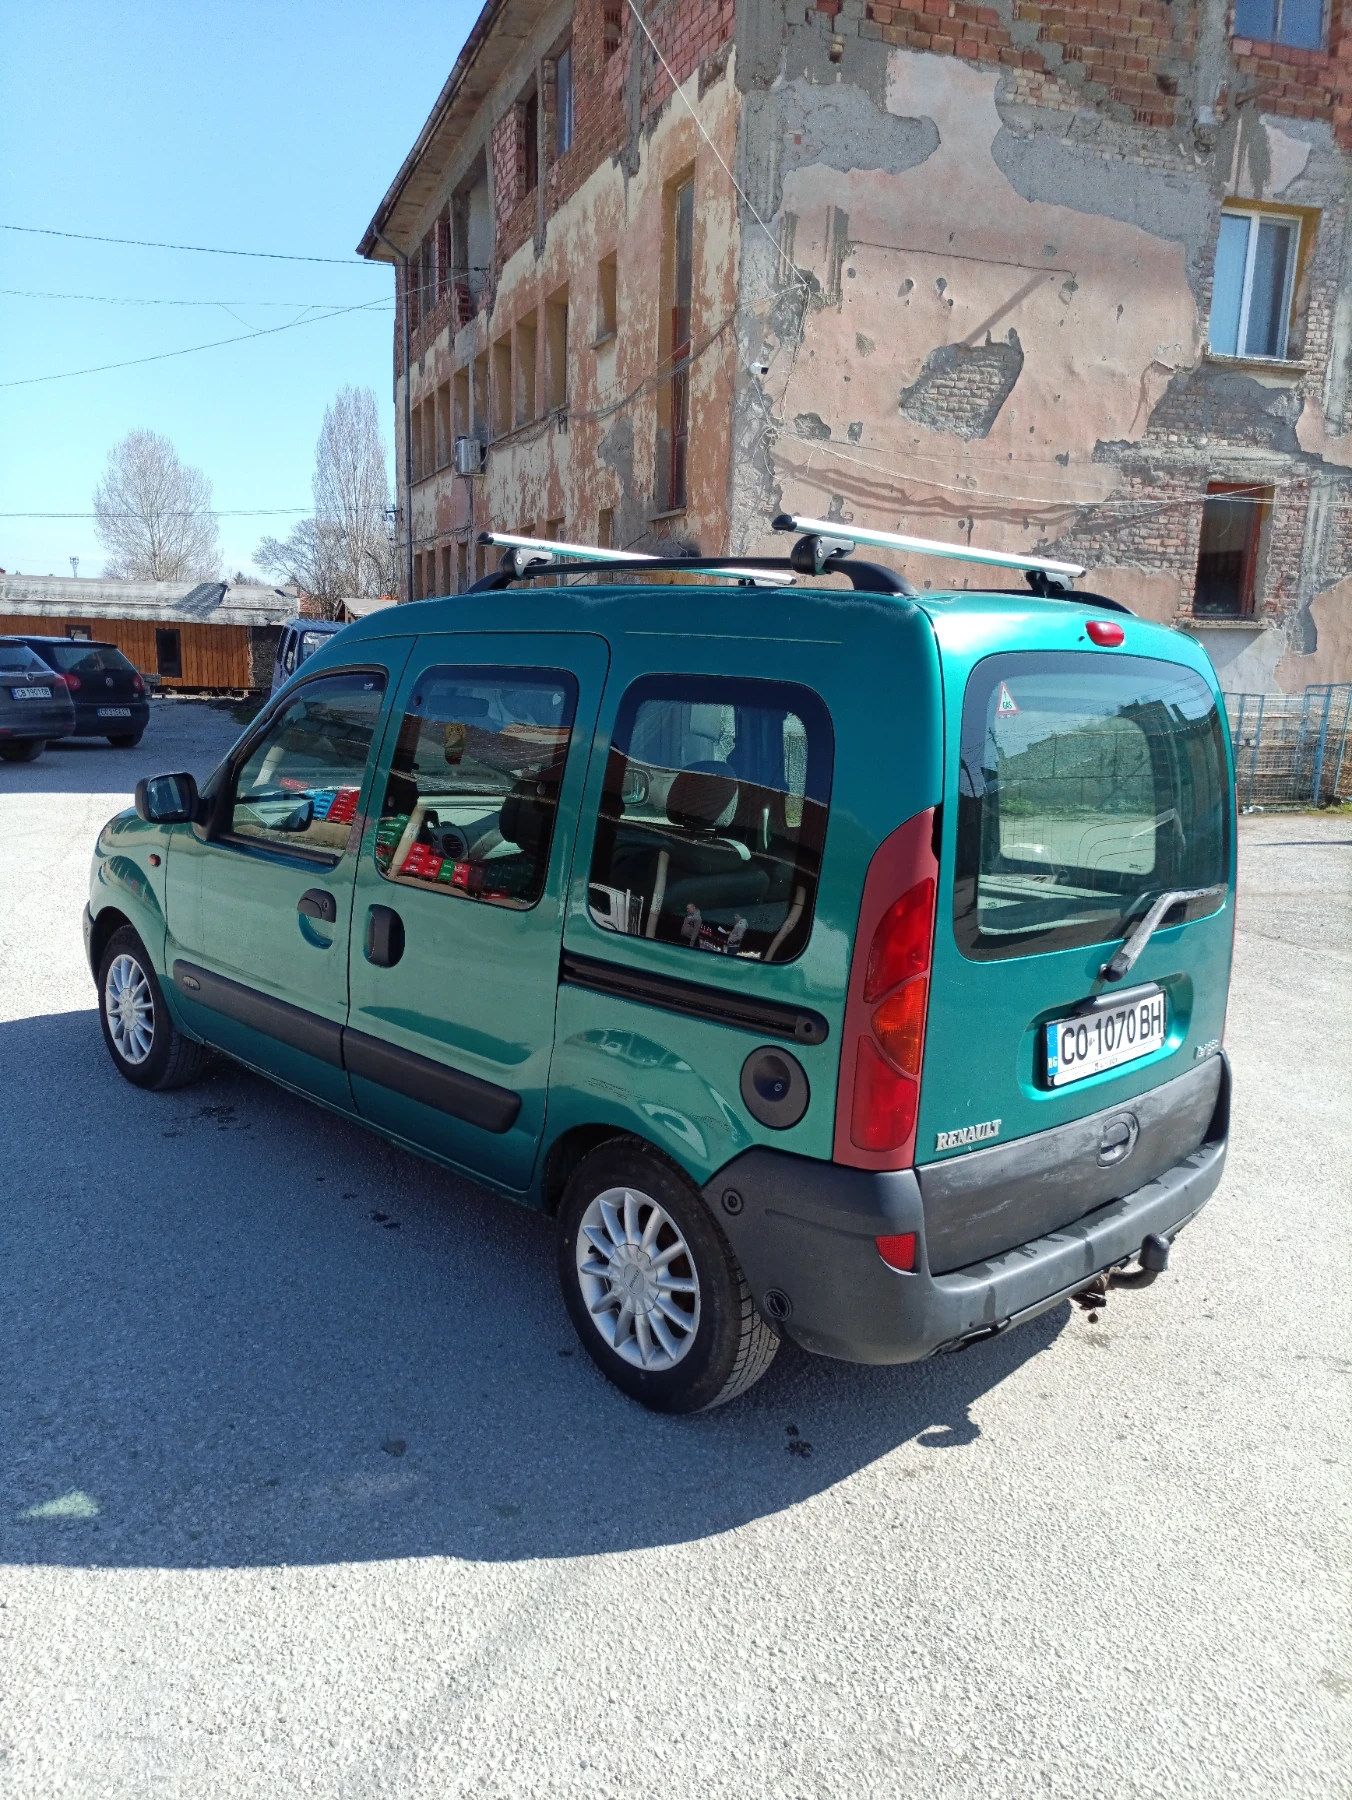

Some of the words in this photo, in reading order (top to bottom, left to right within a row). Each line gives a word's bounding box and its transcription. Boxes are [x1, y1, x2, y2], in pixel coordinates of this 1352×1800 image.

[1061, 1023, 1088, 1066] CO
[1095, 1008, 1136, 1056] 1070
[1140, 1000, 1161, 1041] BH
[935, 1119, 1002, 1151] RENAULT
